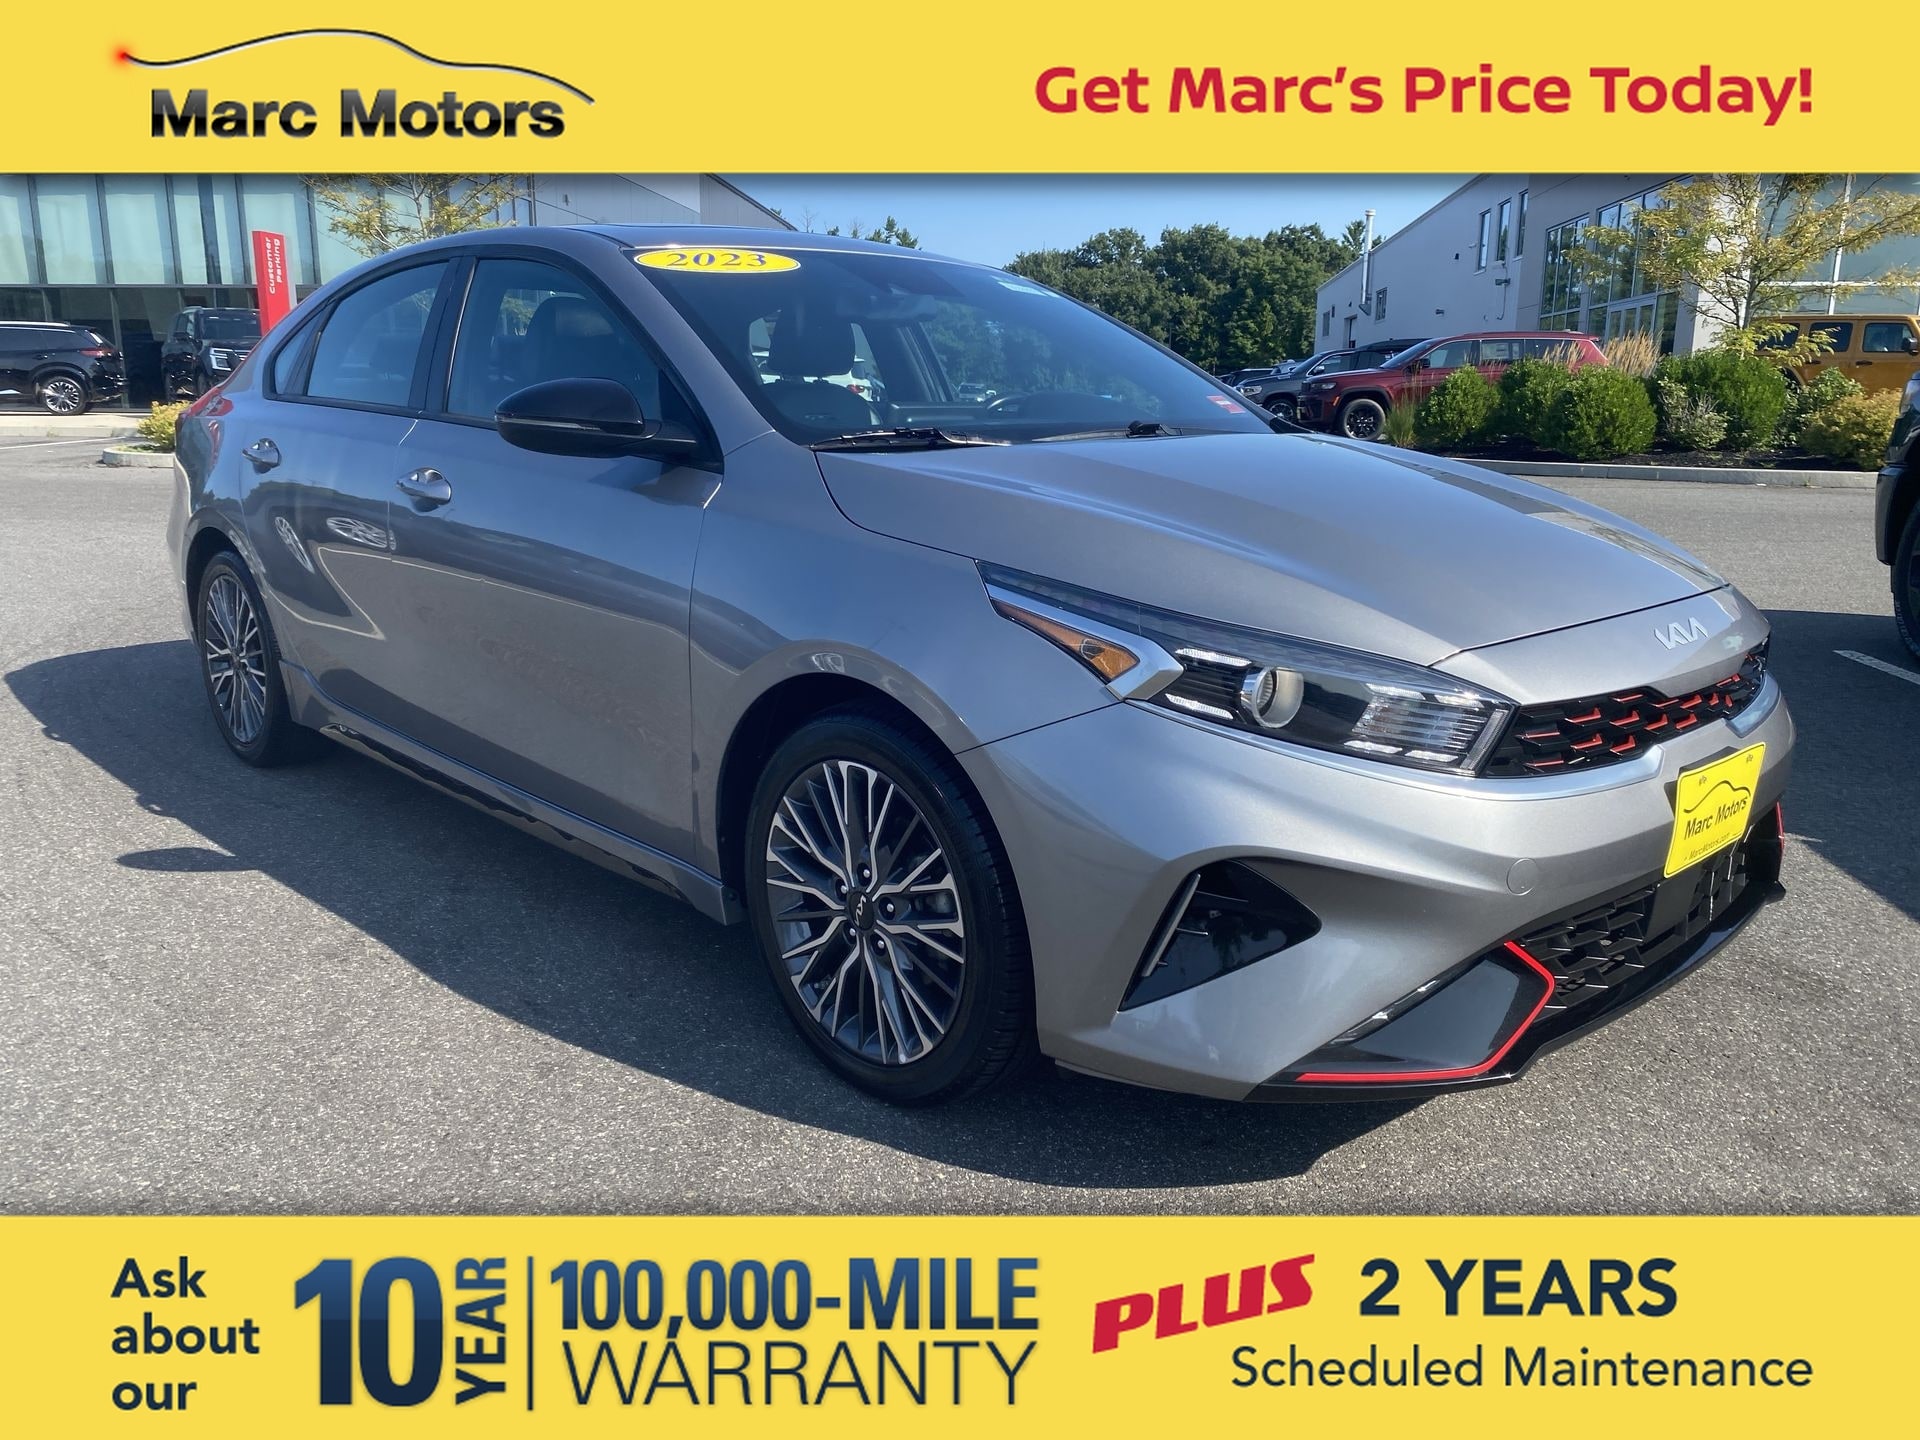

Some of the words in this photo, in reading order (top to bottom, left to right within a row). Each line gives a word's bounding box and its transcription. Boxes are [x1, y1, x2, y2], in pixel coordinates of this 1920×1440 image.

[265, 236, 276, 294] Customer
[667, 253, 767, 266] 2023
[1654, 617, 1709, 650] KIA
[1684, 815, 1713, 840] Marc
[1715, 797, 1748, 825] Motors
